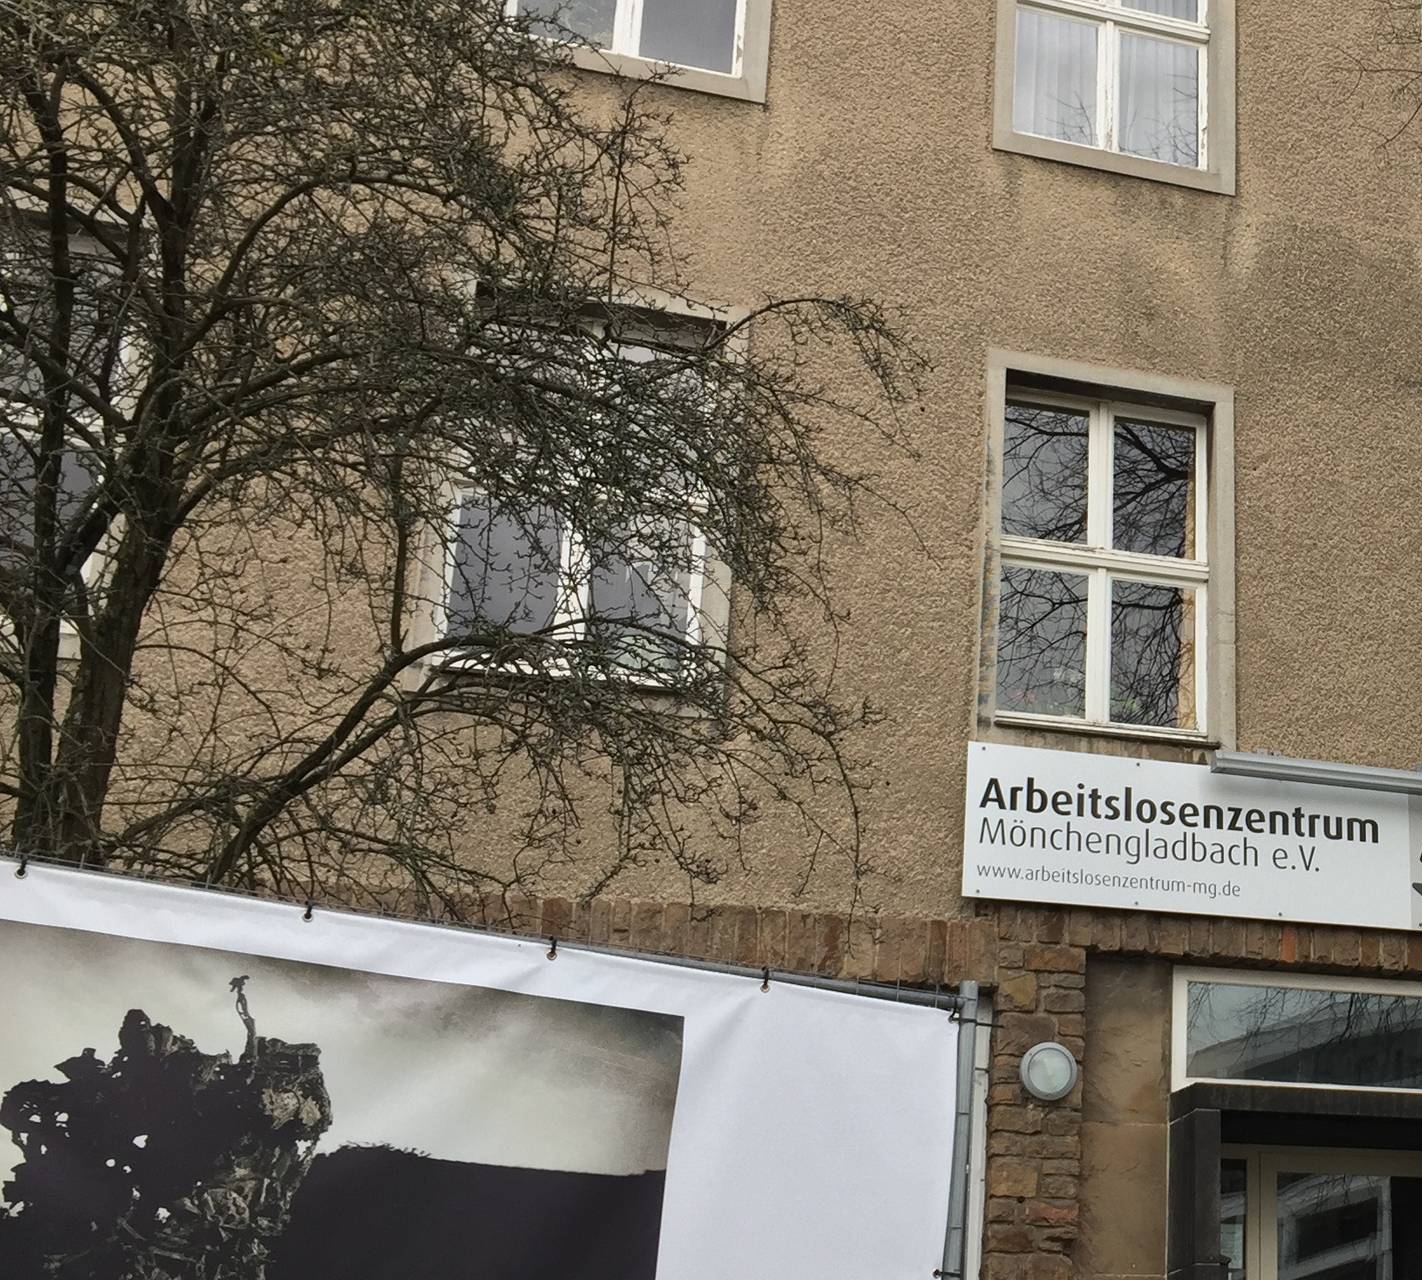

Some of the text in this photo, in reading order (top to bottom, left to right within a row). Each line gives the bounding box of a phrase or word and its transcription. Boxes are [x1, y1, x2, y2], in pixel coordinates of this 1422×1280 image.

[979, 776, 1380, 844] Arbeitslosenzentrum
[979, 816, 1320, 872] Mönchengladbach e.V.
[976, 864, 1242, 899] www.arbeitslosenzentrum-mg.de
